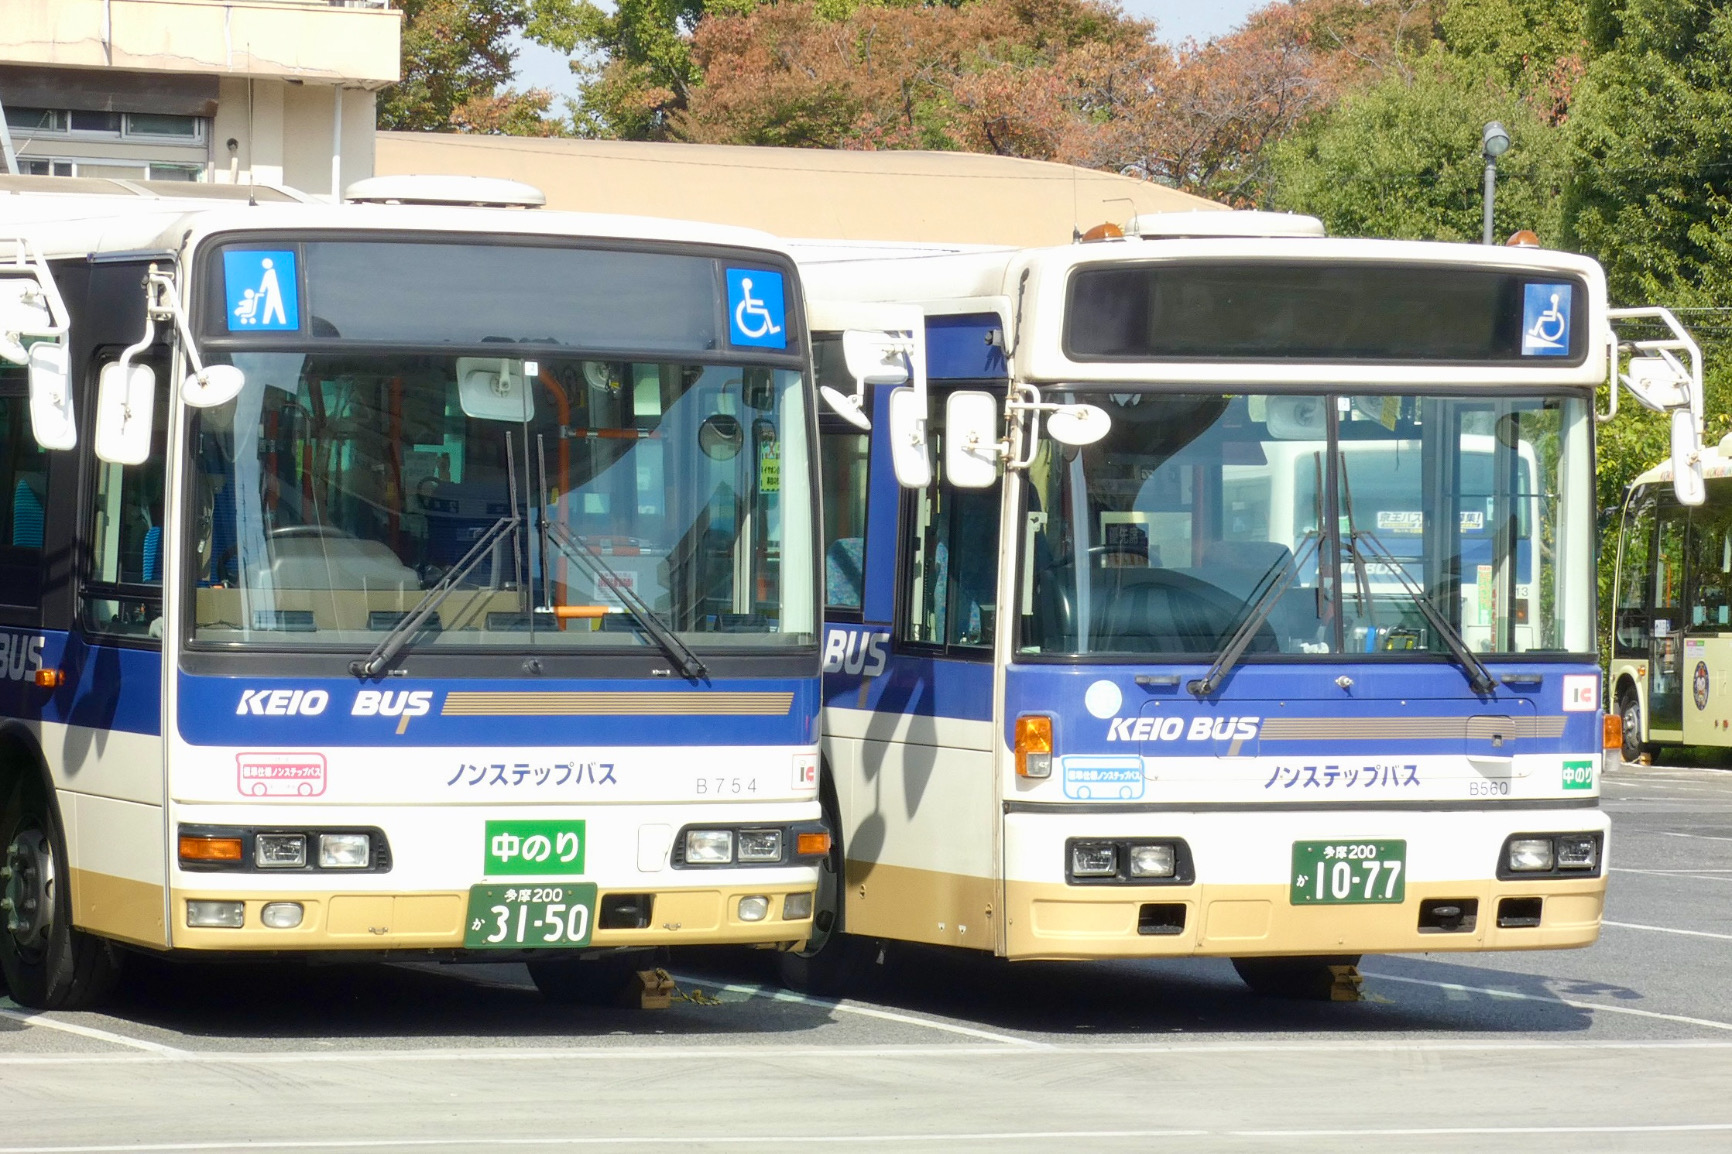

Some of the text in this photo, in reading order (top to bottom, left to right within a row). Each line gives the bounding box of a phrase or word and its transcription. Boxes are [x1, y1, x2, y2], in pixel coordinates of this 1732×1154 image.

[823, 629, 890, 677] BUS
[236, 689, 433, 716] KEIO BUS
[1106, 716, 1260, 741] KEIO BUS
[447, 761, 617, 787] ノンステップバス
[696, 778, 757, 794] B754
[1264, 764, 1421, 789] ノンステップバス
[1562, 767, 1593, 784] 中のり
[1470, 781, 1508, 796] B560
[491, 832, 579, 862] 中のり
[1296, 860, 1401, 900] か 10-77
[471, 903, 588, 943] か 31-50
